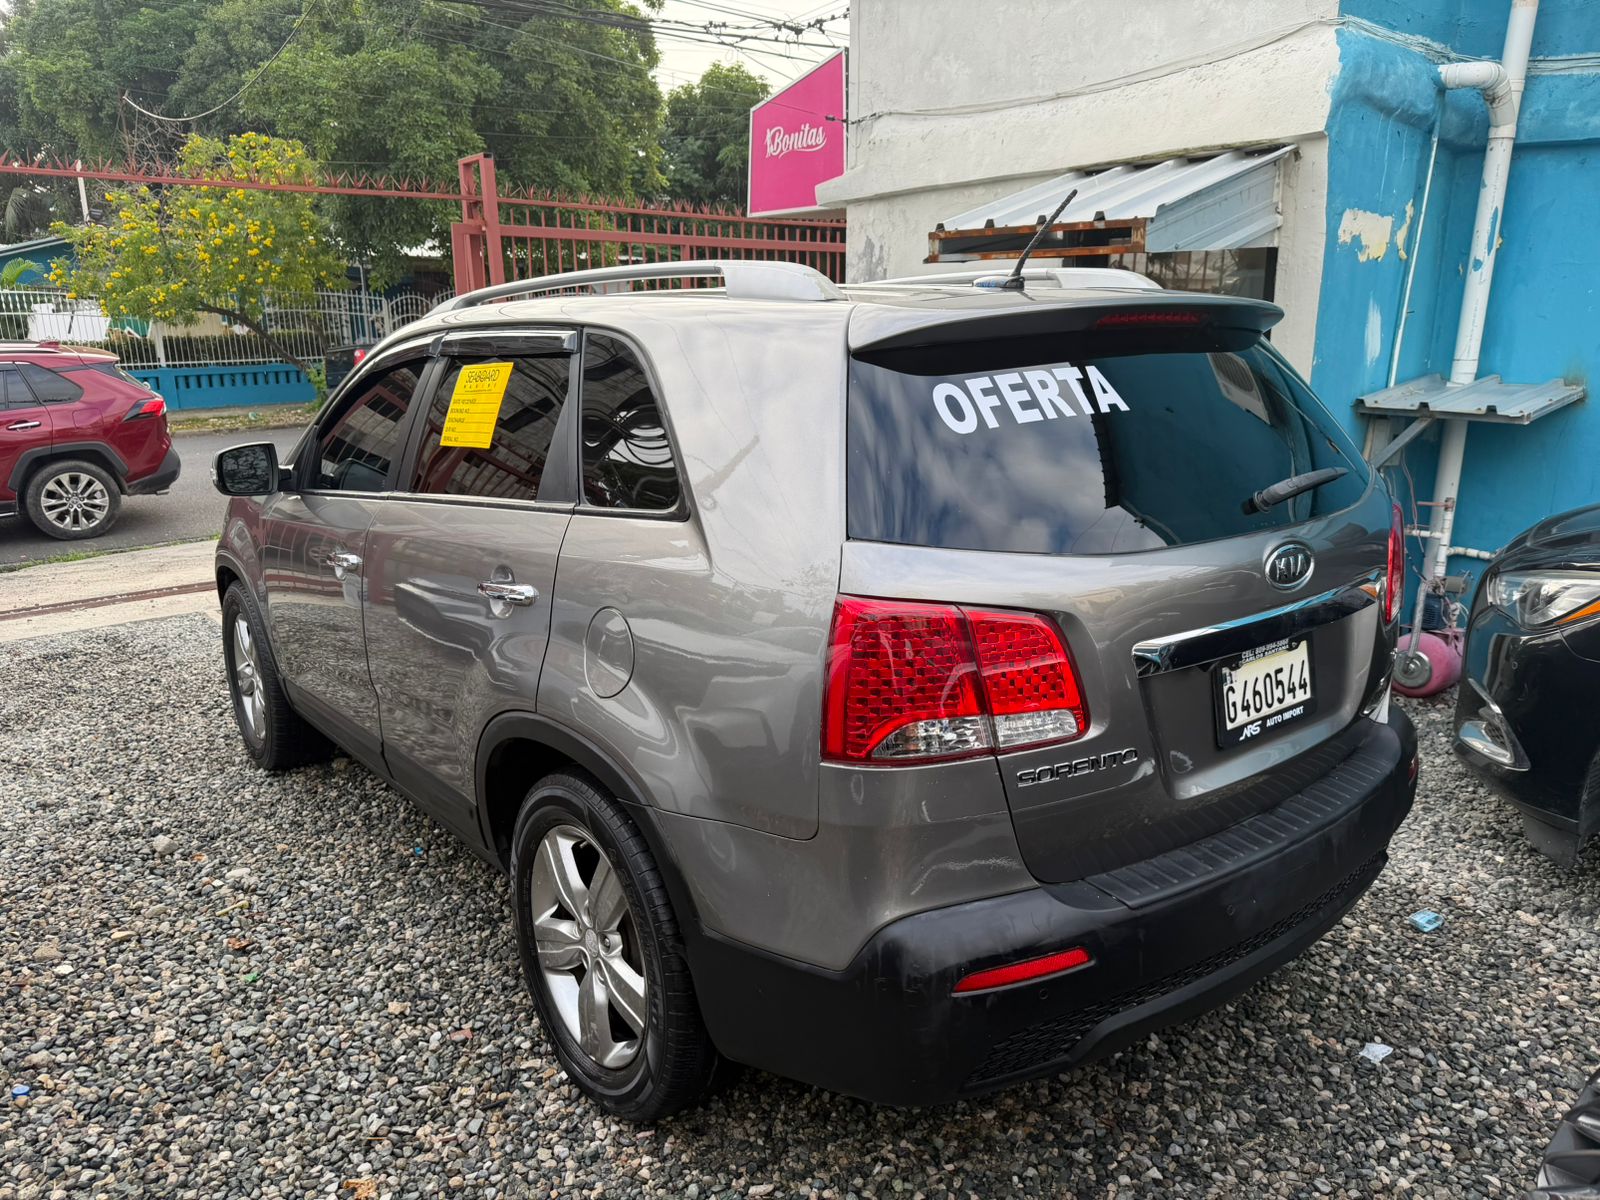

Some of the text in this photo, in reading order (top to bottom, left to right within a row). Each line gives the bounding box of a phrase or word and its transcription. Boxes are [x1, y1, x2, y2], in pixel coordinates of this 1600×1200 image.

[764, 123, 827, 159] Bonitas
[932, 365, 1131, 435] OFERTA
[1275, 553, 1308, 581] KIA
[1226, 660, 1308, 723] G460544
[1266, 714, 1282, 727] AUTO
[1282, 706, 1305, 720] IMPORT
[1017, 747, 1138, 788] SORENTO
